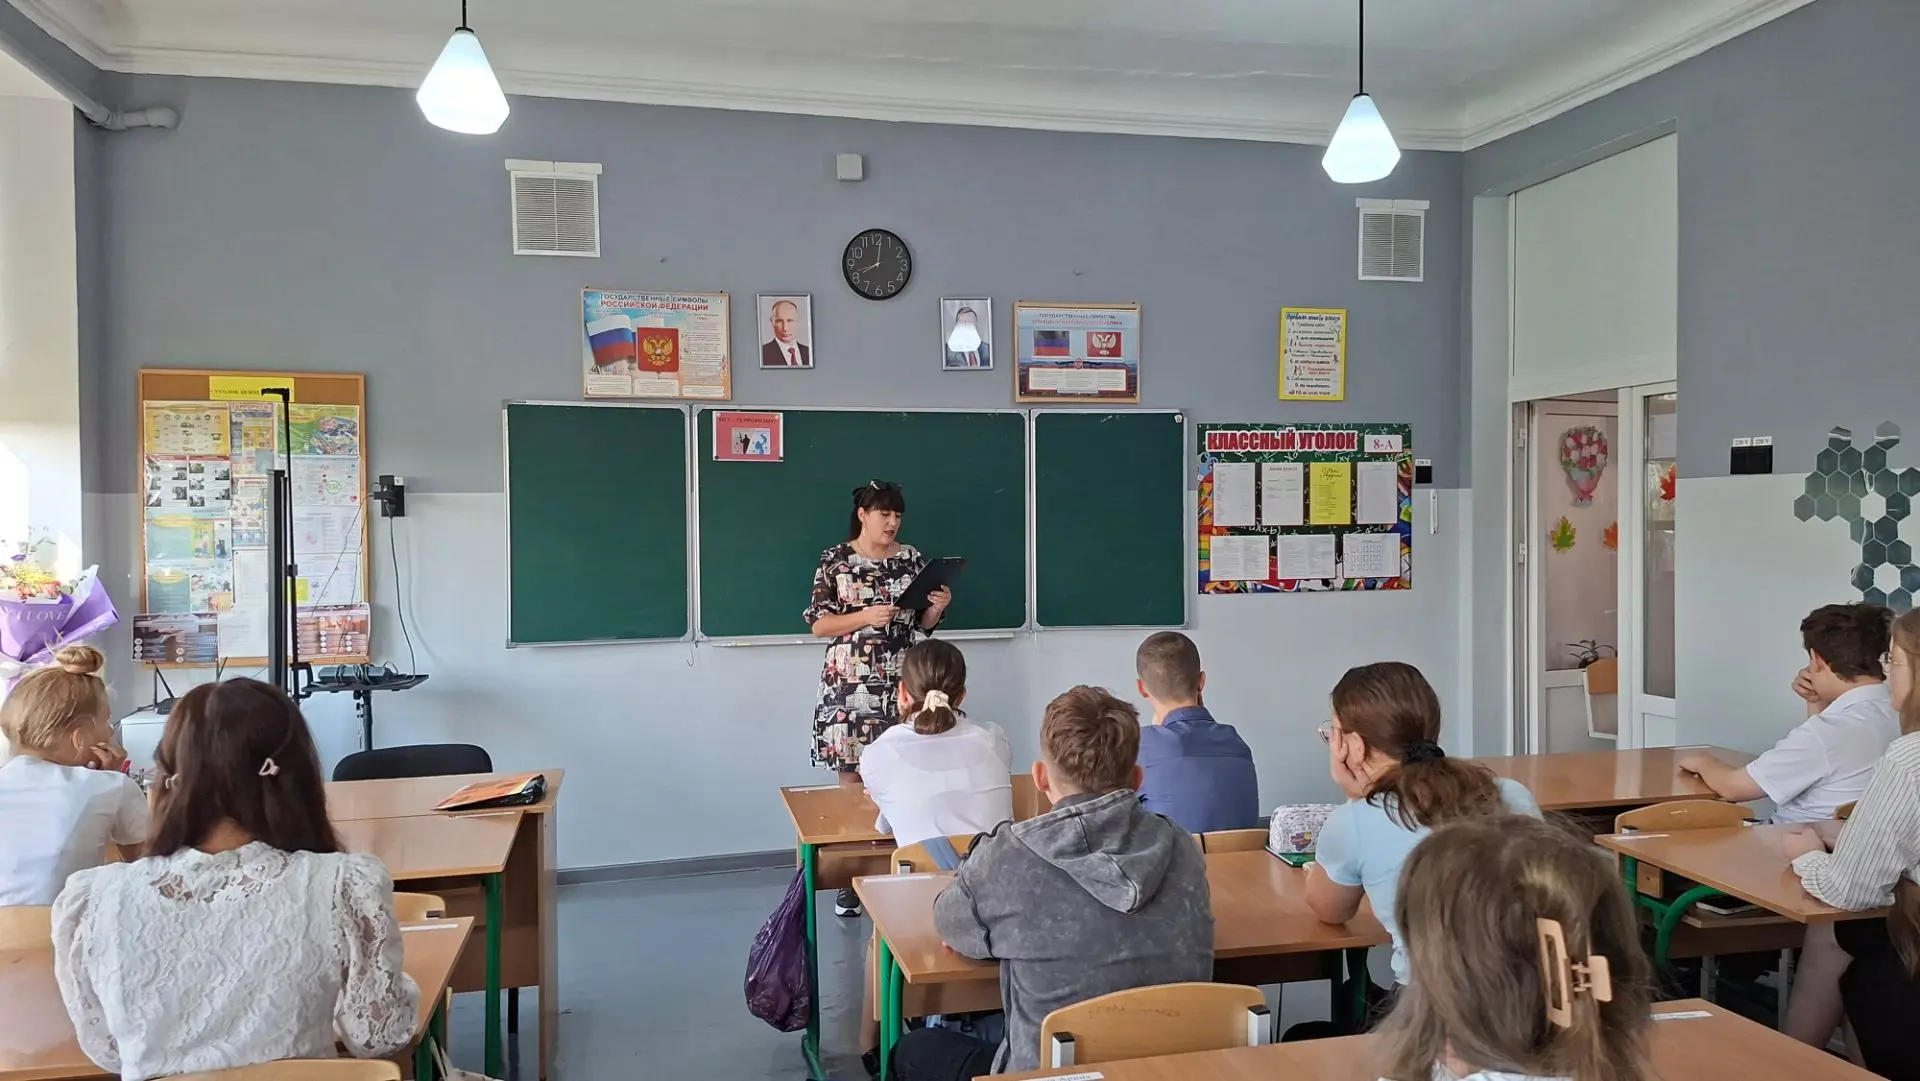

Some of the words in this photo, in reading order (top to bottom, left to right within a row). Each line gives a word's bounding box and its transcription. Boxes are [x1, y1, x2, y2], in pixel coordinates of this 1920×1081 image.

[861, 236, 868, 248] 11
[871, 234, 882, 246] 12
[887, 236, 892, 249] 1
[851, 246, 863, 259] 10
[895, 246, 904, 258] 2
[847, 258, 855, 270] 9
[900, 259, 908, 272] 3
[852, 272, 860, 284] 8
[896, 272, 904, 283] 4
[863, 280, 871, 292] 7
[875, 285, 883, 297] 6
[887, 280, 896, 293] 5
[659, 302, 709, 311] ФЕДЕРАЦИИ
[1207, 429, 1296, 450] КЛАССНЫЙ
[1298, 431, 1357, 450] УГОЛОК
[26, 611, 65, 621] LOVE
